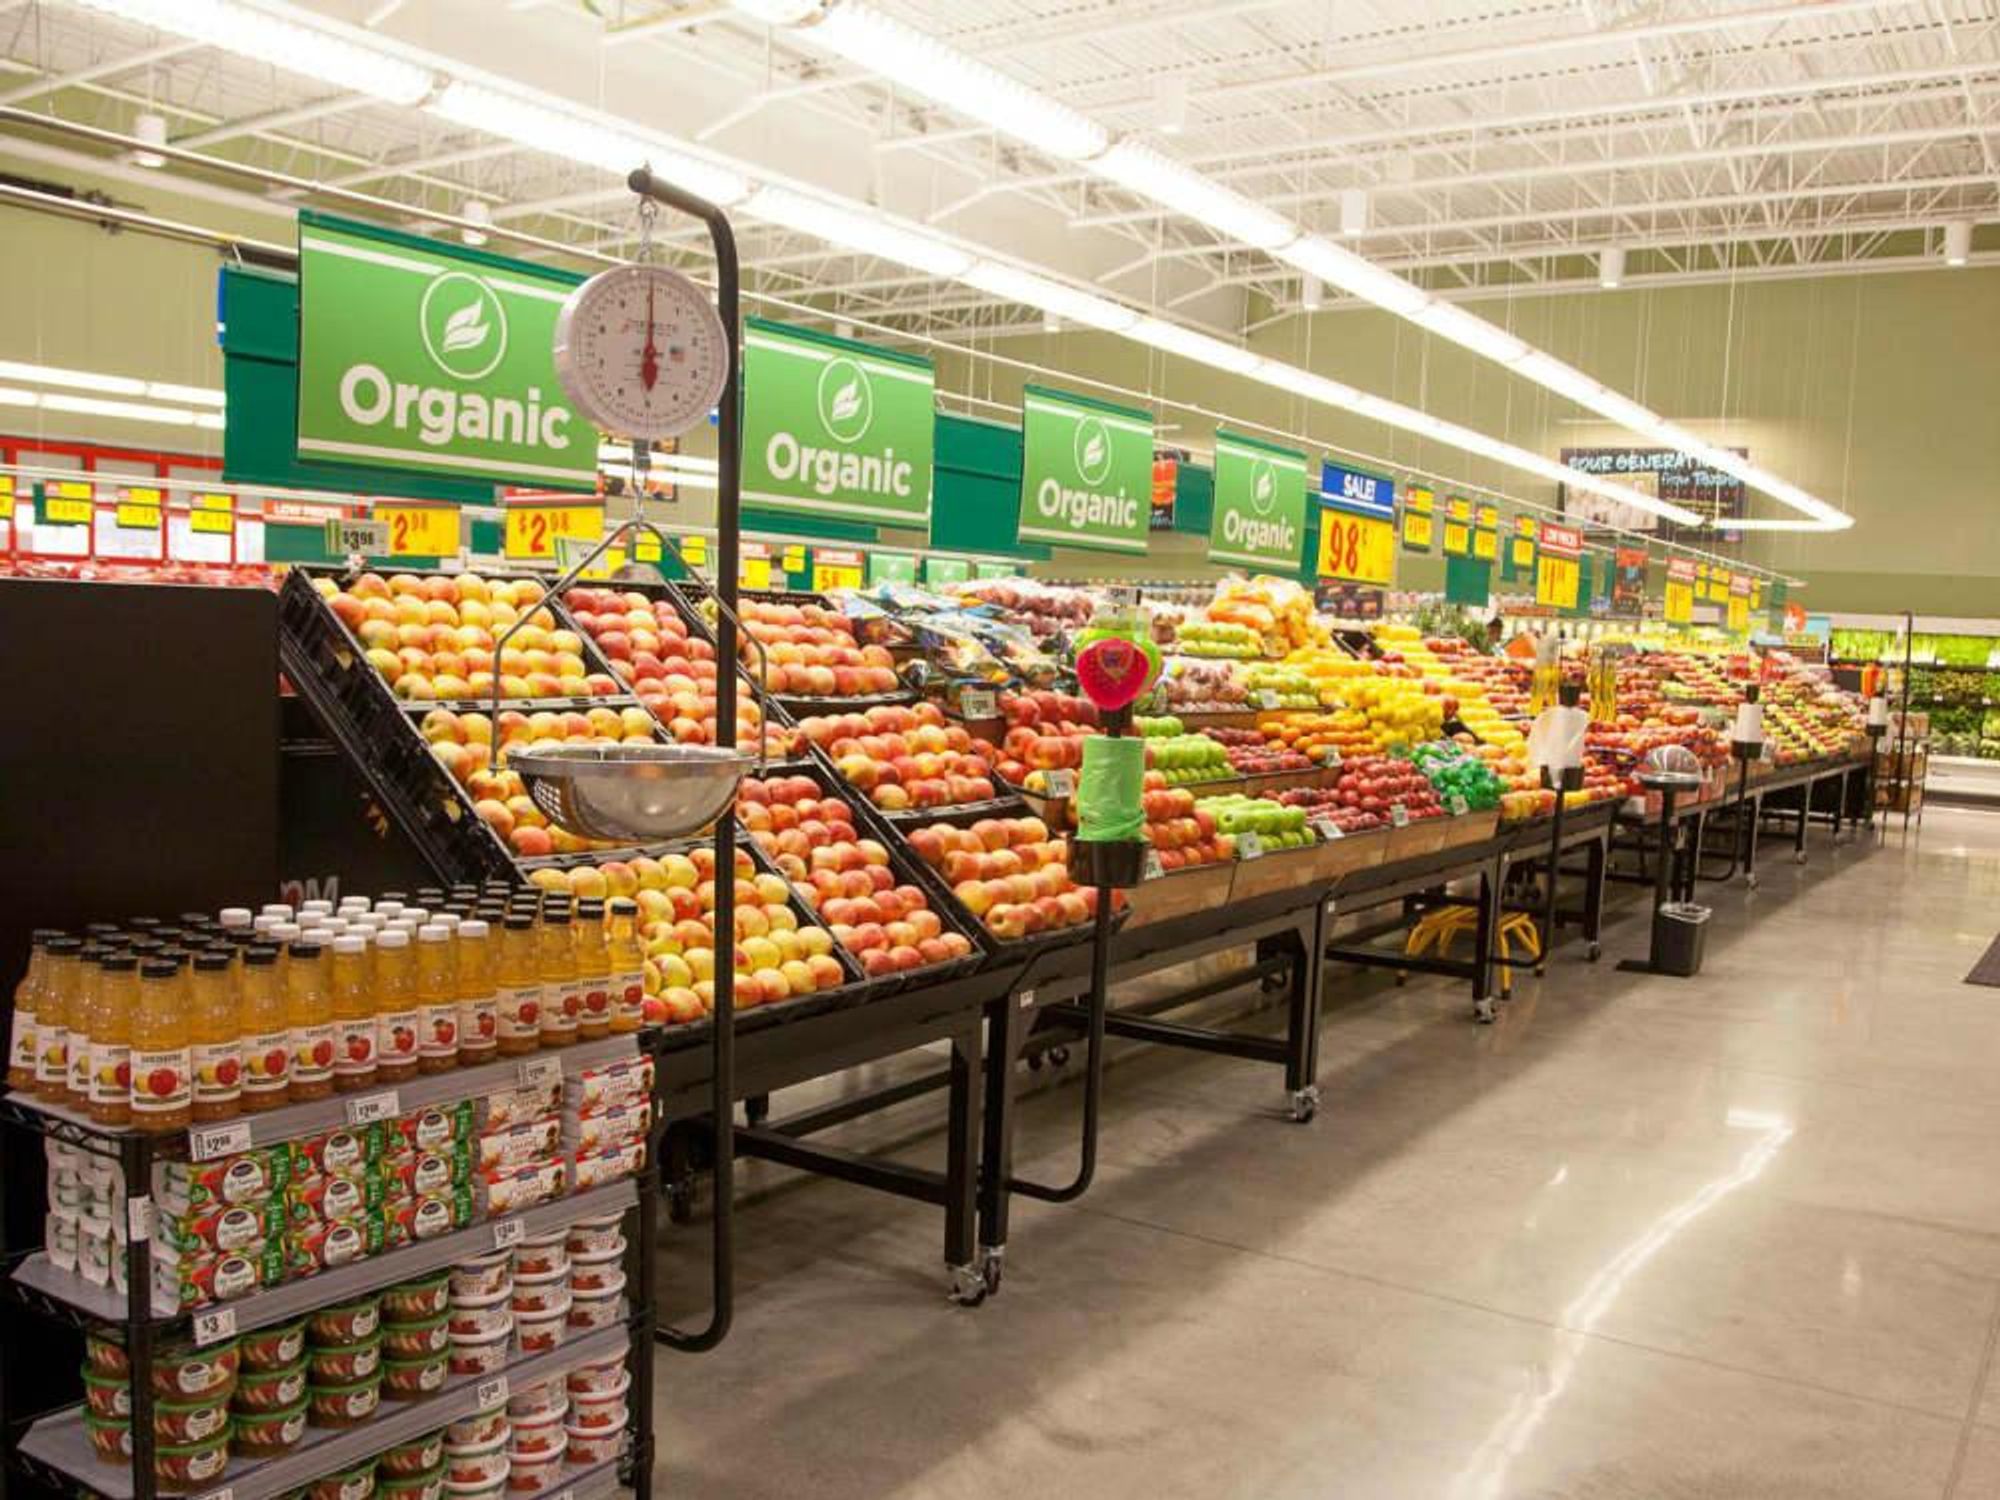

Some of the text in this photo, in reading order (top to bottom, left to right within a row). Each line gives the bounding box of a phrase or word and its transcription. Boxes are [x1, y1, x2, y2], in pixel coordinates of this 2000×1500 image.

[340, 363, 571, 449] Organic
[766, 431, 912, 497] Organic
[1343, 473, 1376, 501] SALE!
[1038, 478, 1138, 529] Organic
[1223, 508, 1294, 551] Organic
